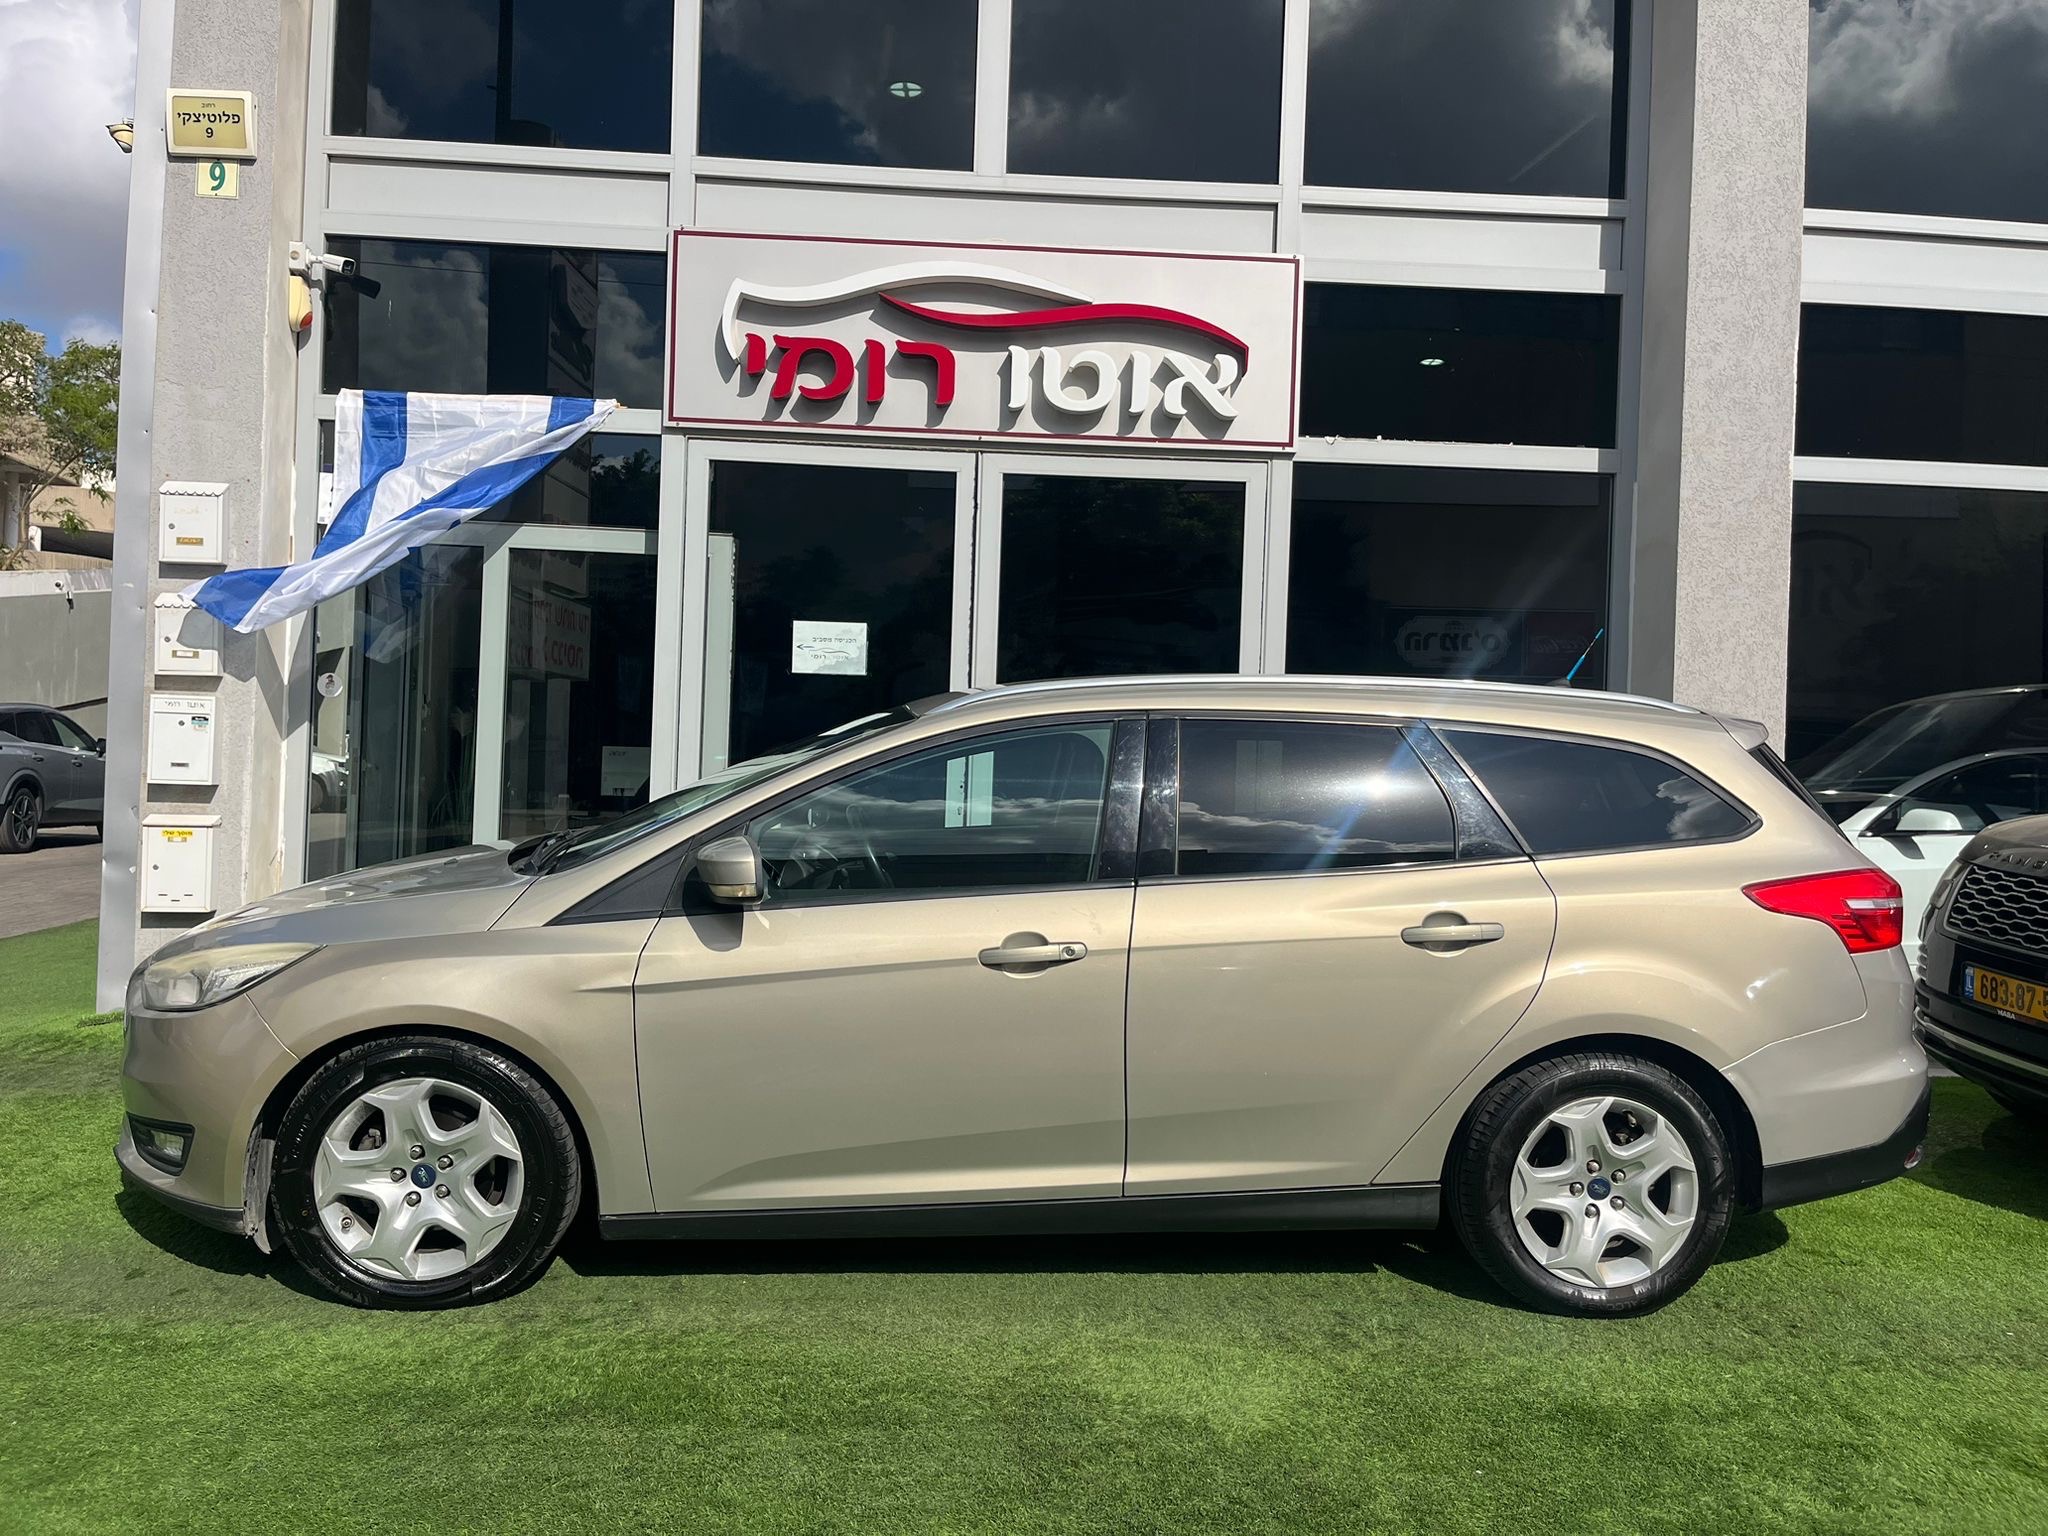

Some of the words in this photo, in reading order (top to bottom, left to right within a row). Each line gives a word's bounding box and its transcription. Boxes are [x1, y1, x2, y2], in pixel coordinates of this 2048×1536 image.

[177, 111, 241, 125] פלוטיצקי
[205, 127, 214, 138] 9
[209, 161, 226, 191] 9
[745, 332, 955, 407] רומי
[1007, 345, 1239, 420] אוטו
